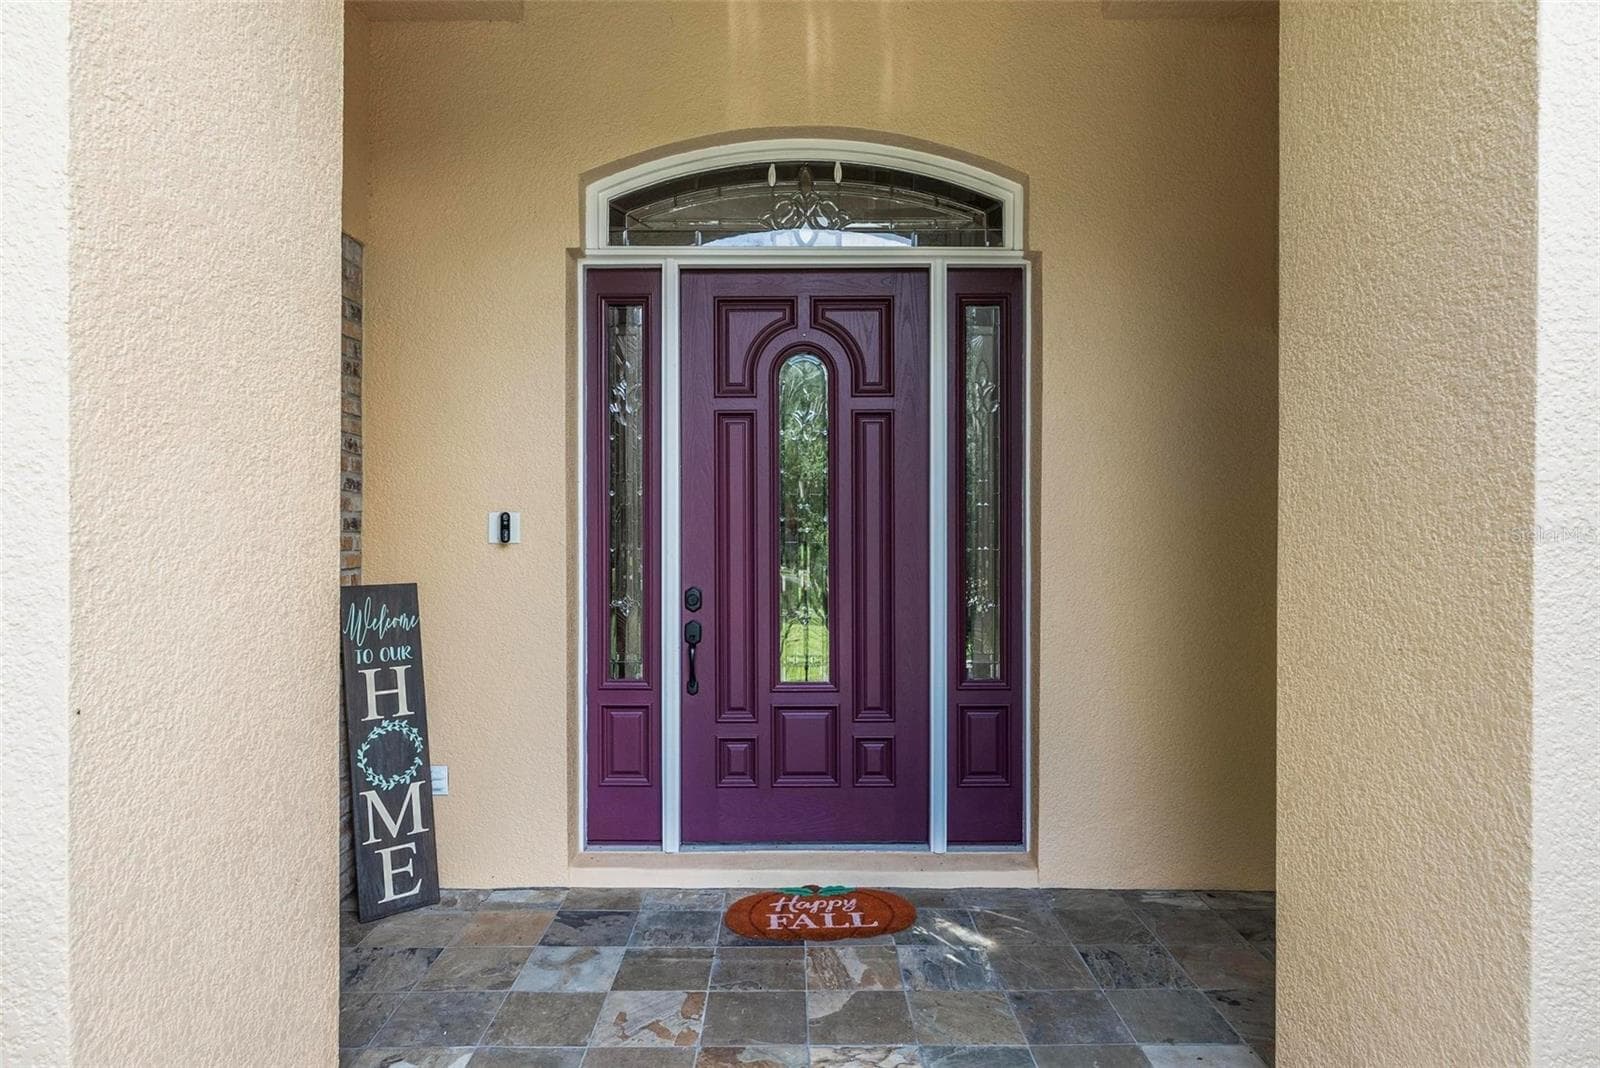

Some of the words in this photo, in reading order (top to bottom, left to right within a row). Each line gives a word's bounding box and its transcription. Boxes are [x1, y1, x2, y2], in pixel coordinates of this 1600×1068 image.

[343, 596, 420, 647] Welcome
[354, 648, 374, 664] TO
[380, 645, 413, 662] OUR
[769, 895, 857, 913] Happy
[766, 912, 879, 930] FALL
